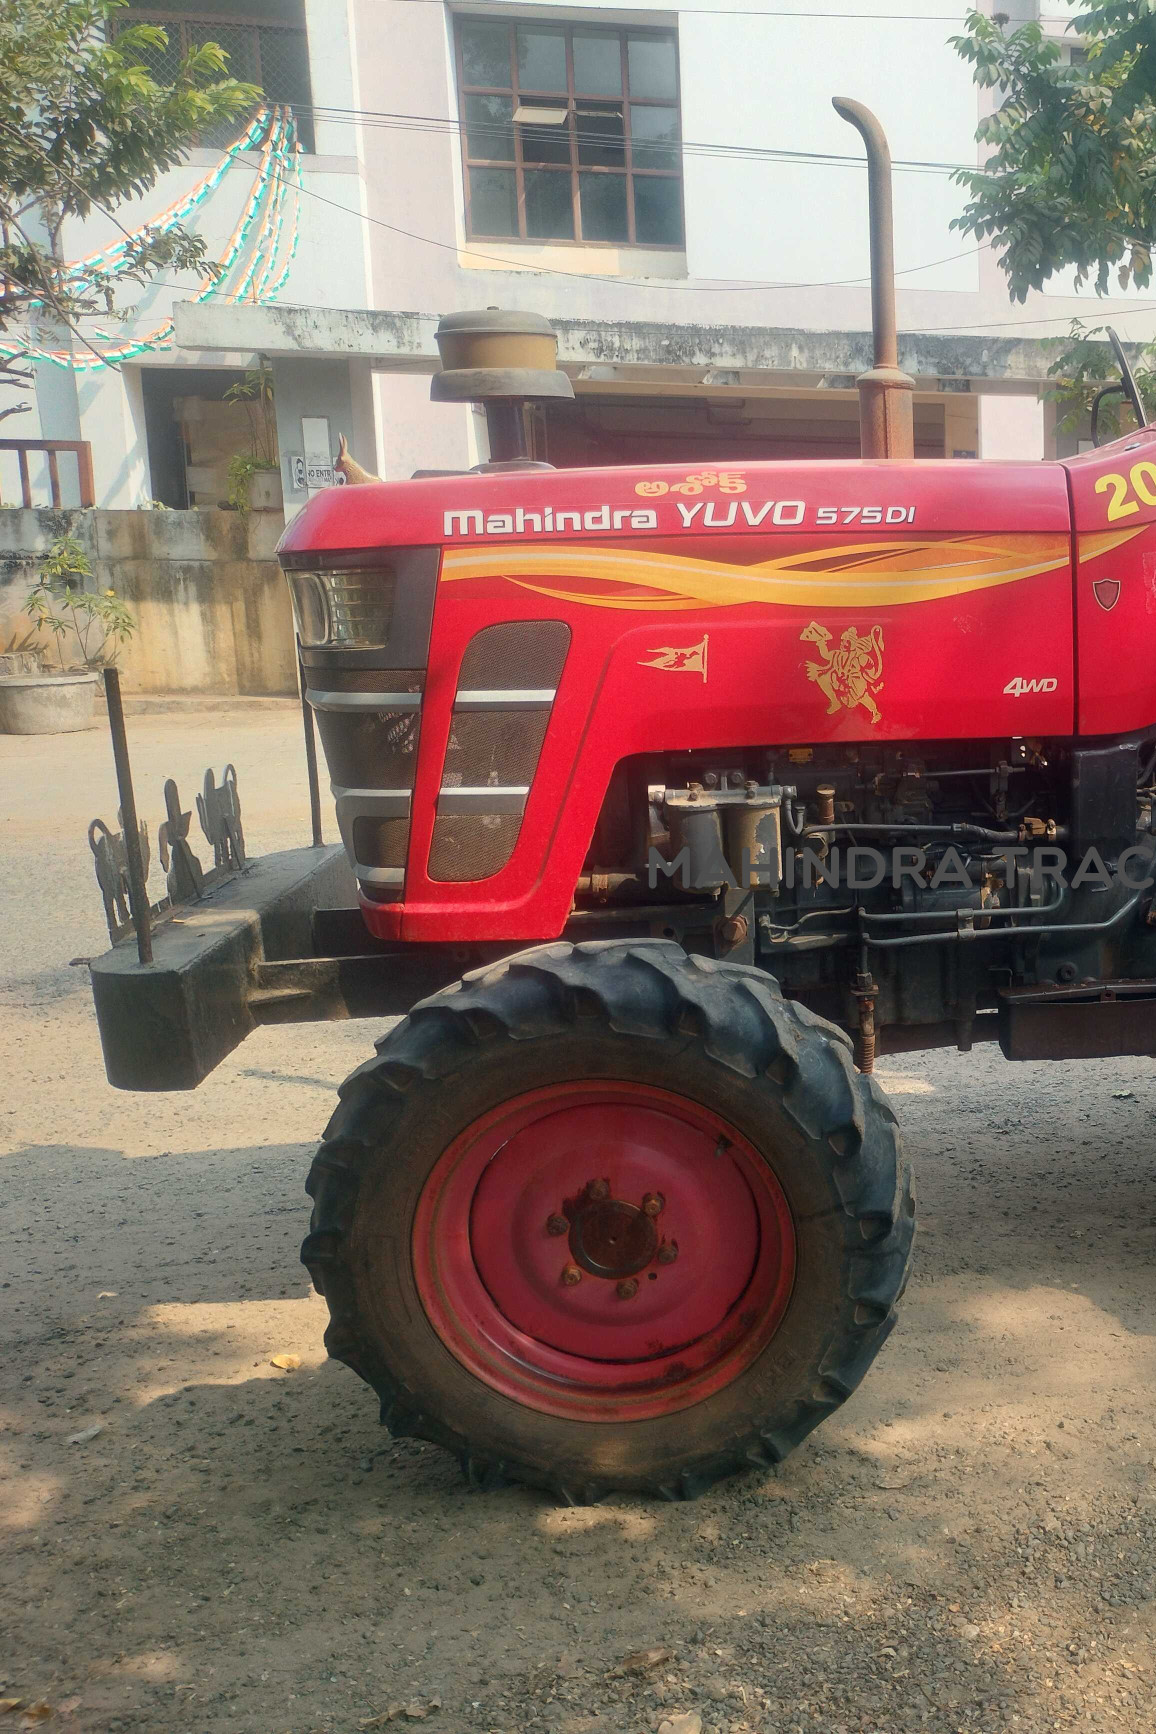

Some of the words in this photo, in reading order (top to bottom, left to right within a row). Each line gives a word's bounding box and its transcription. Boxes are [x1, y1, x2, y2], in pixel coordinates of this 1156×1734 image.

[443, 505, 658, 537] Mahindra
[676, 500, 806, 529] YUVO
[1003, 677, 1058, 698] 4WD
